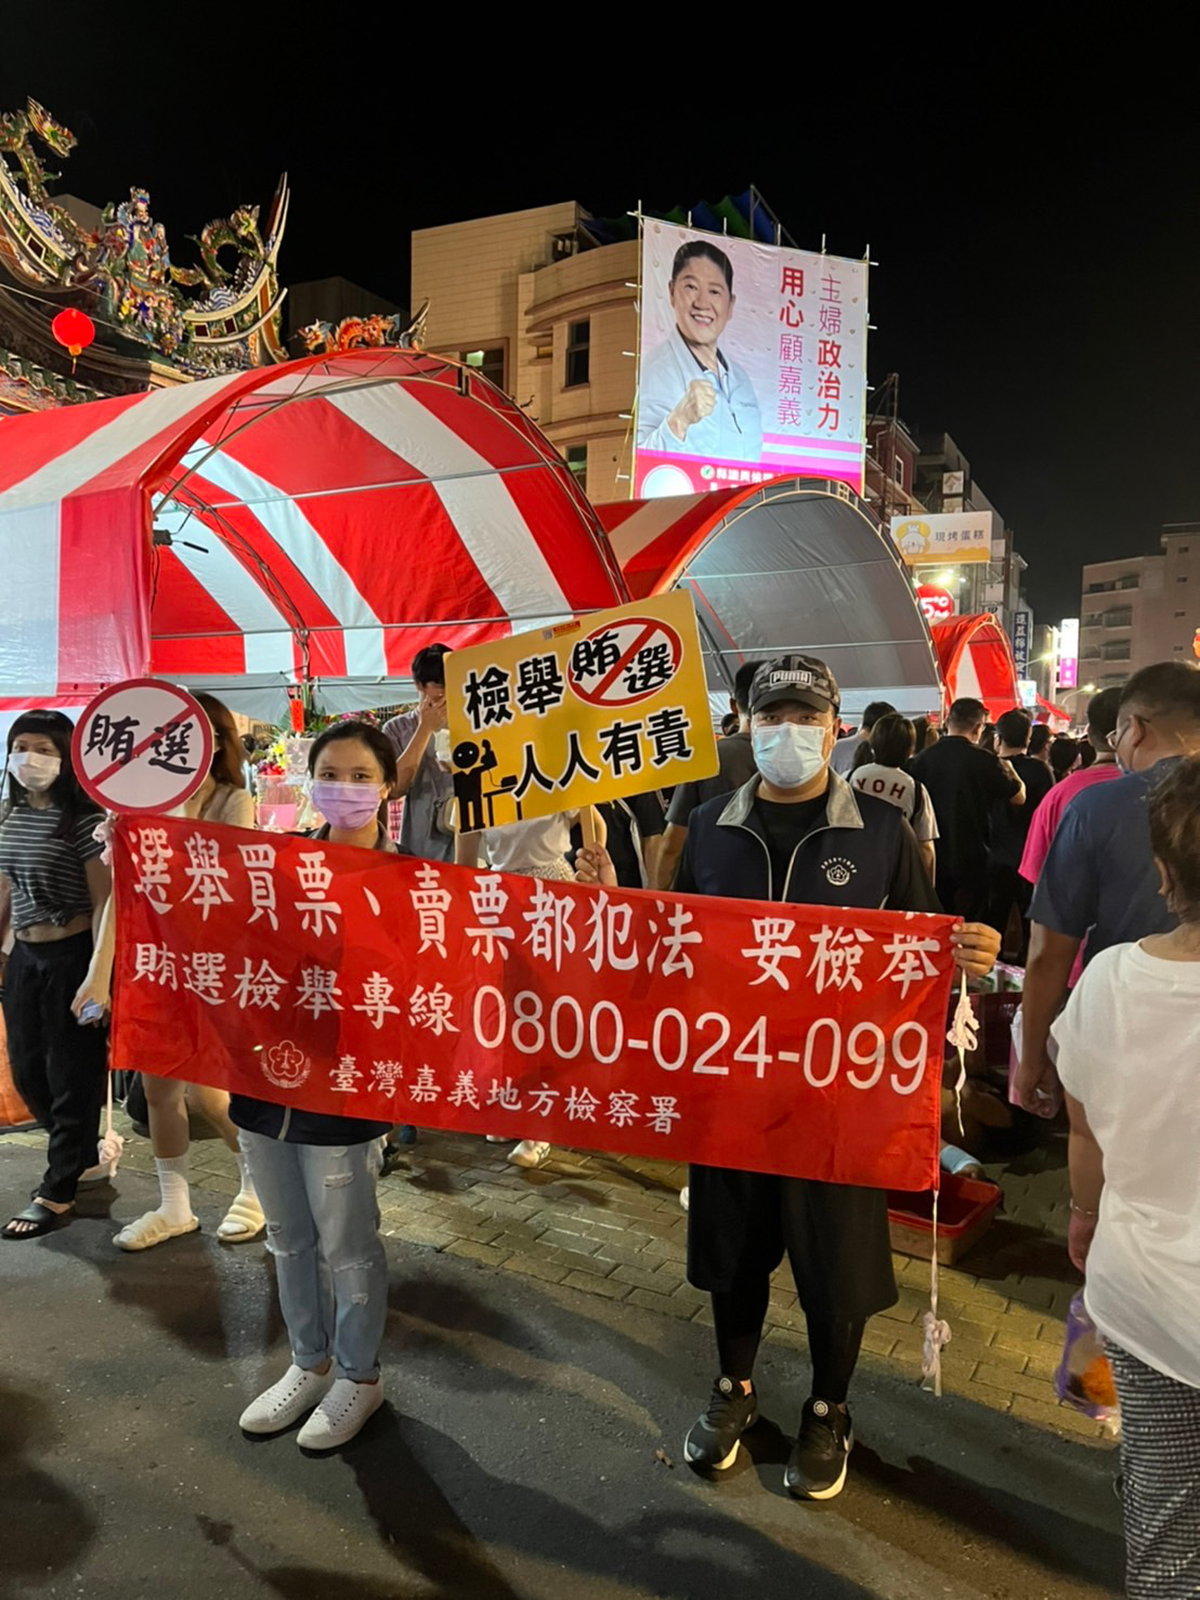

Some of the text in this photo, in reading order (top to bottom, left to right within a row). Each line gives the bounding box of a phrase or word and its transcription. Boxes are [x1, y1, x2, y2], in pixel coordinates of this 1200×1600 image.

[777, 266, 804, 426] 用心顧嘉義
[817, 274, 842, 431] 主婦政治力
[935, 530, 984, 542] 現烤蛋糕
[773, 670, 809, 683] PUMA
[84, 713, 197, 774] 賄選
[513, 708, 692, 798] 人人有責
[856, 778, 906, 799] YOH
[329, 1054, 682, 1135] 臺灣嘉義地方檢察署
